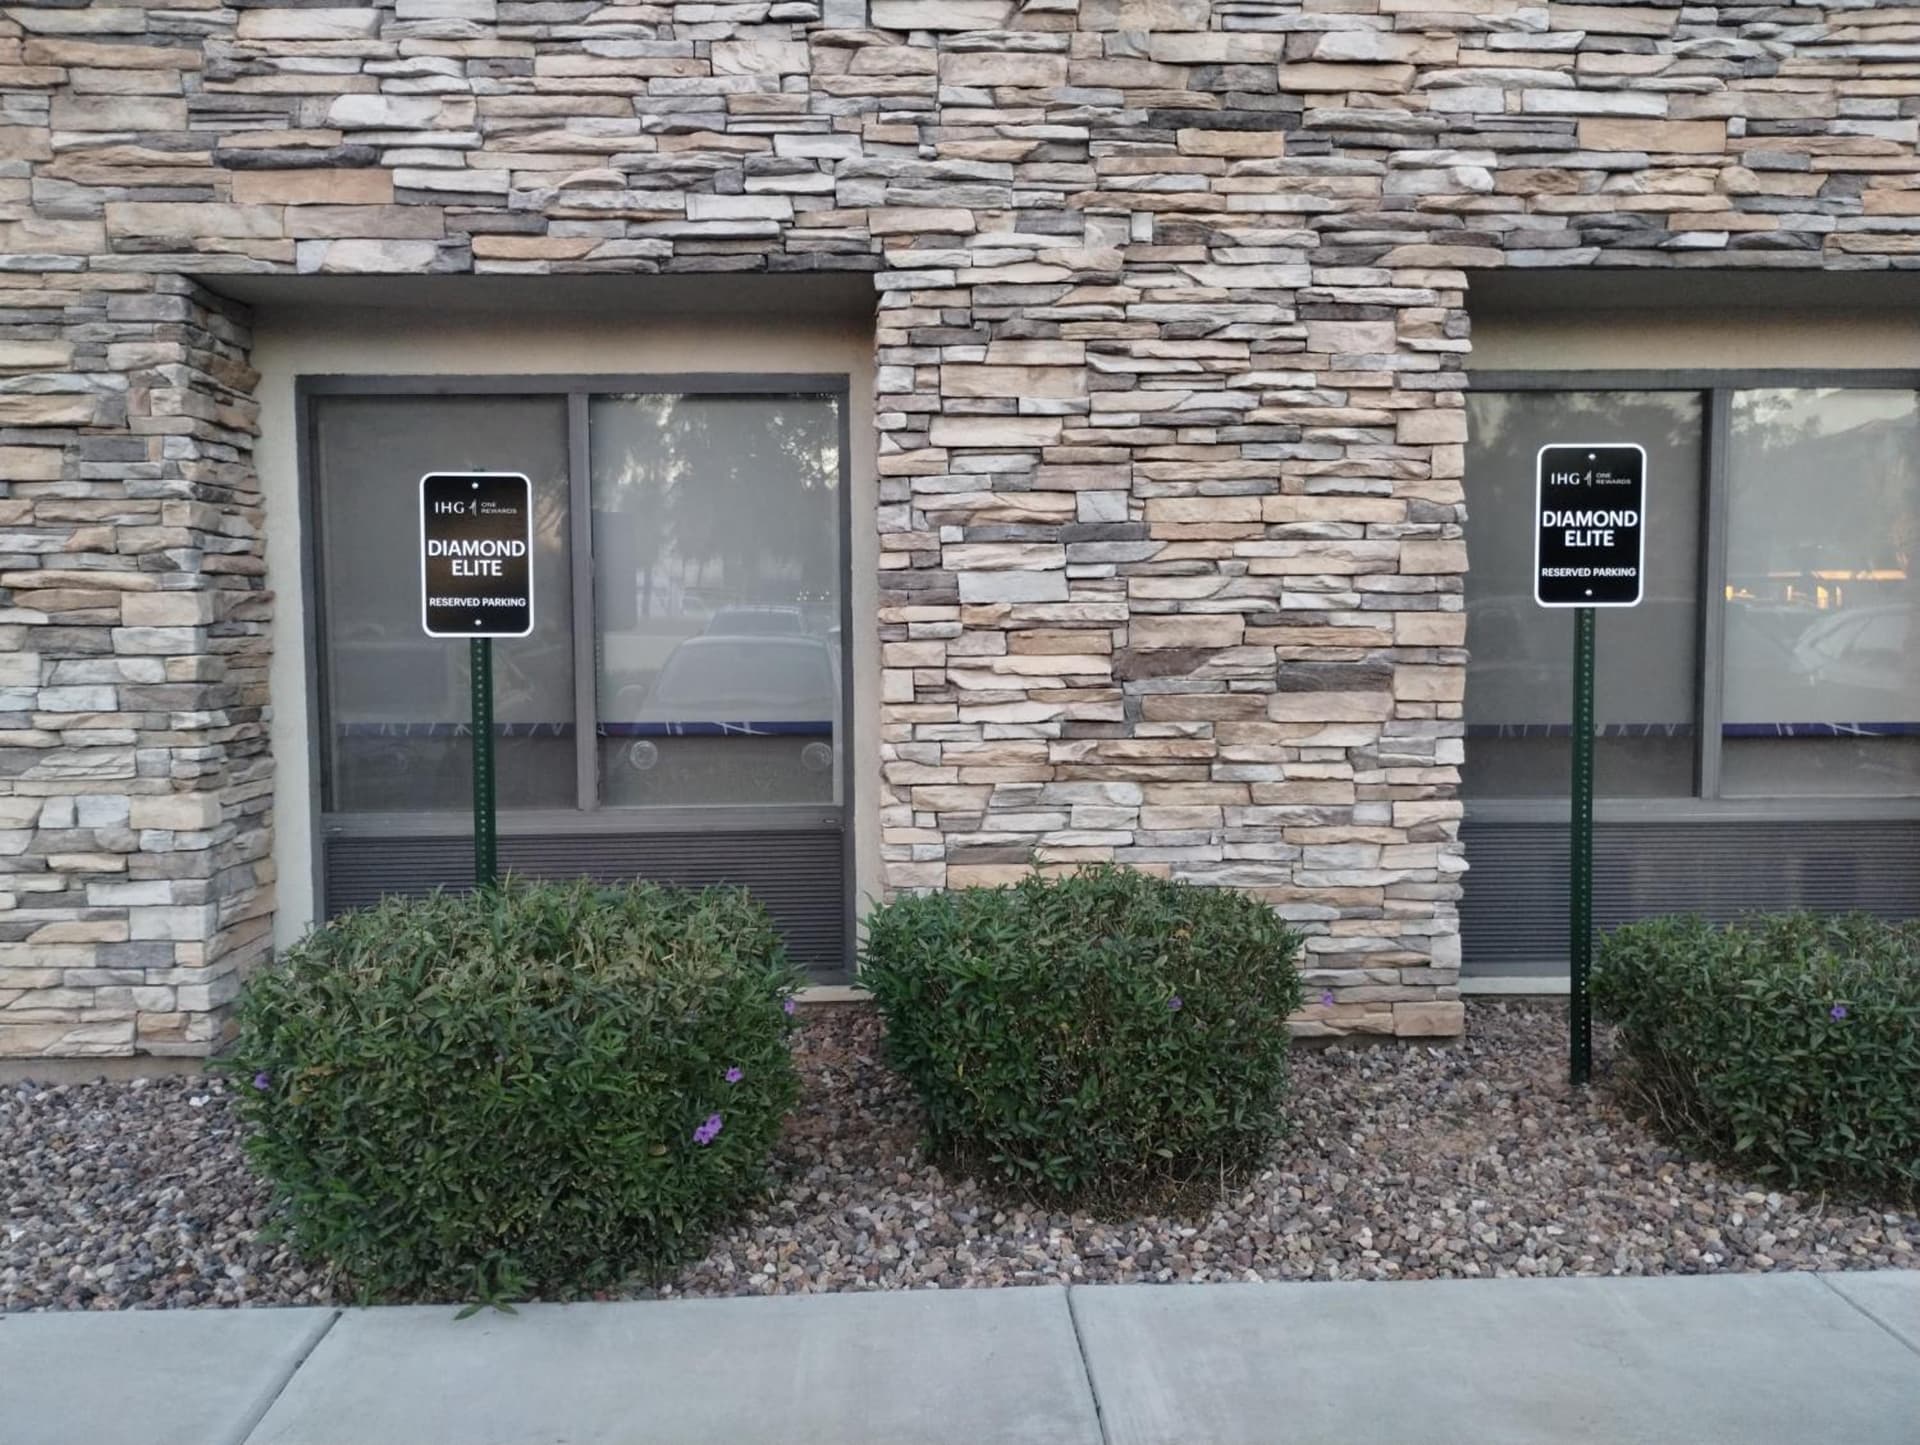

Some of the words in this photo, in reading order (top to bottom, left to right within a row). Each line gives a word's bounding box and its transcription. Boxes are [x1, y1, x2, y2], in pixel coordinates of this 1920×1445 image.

[1551, 472, 1580, 485] IHG
[434, 501, 465, 514] IHG
[1542, 510, 1638, 527] DIAMOND
[1564, 530, 1615, 547] ELITE
[428, 540, 526, 557] DIAMOND
[451, 560, 503, 576] ELITE
[1541, 567, 1591, 577] RESERVED
[1593, 567, 1636, 577] PARKING
[429, 597, 480, 607] RESERVED
[482, 597, 526, 607] PARKING
